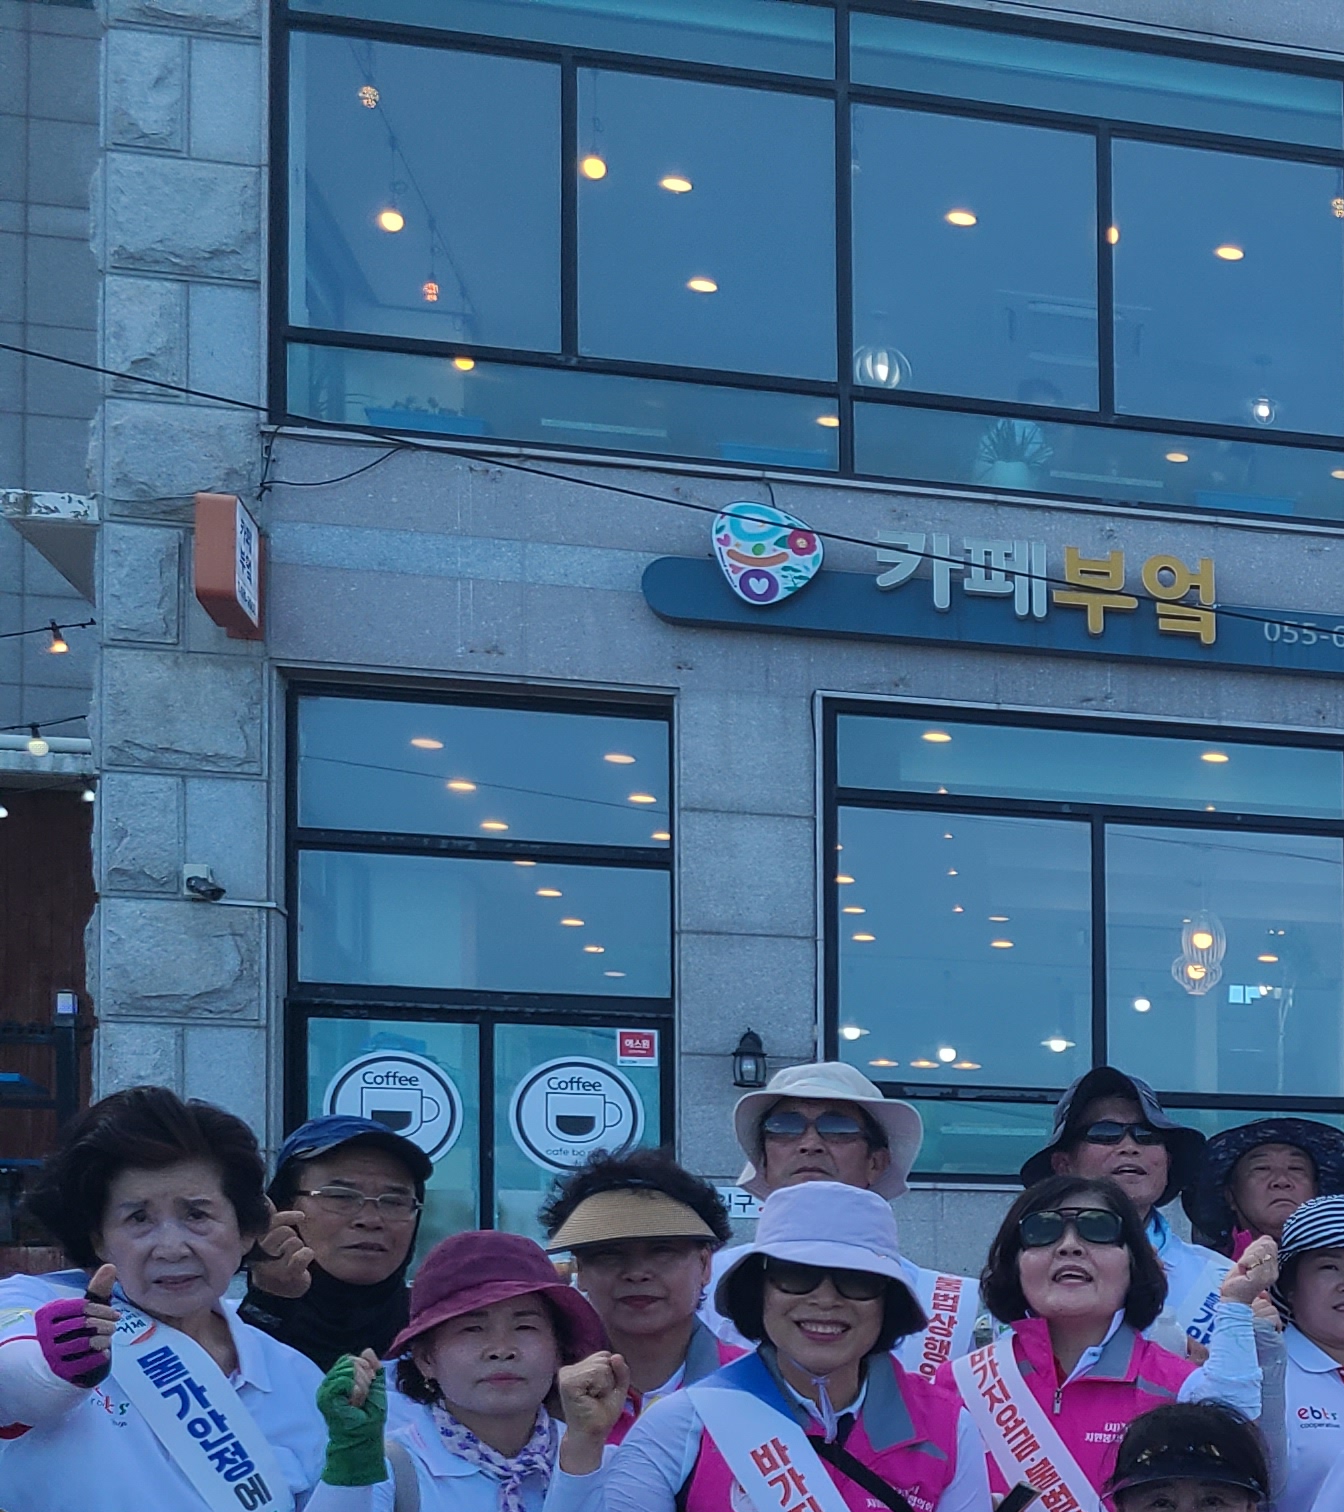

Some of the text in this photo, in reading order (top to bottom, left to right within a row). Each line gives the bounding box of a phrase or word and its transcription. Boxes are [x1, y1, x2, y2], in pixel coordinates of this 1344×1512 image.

[362, 1070, 419, 1087] Coffee
[547, 1076, 602, 1091] Coffee
[1297, 1405, 1338, 1421] ebts
[137, 1345, 273, 1511] 물가안정에
